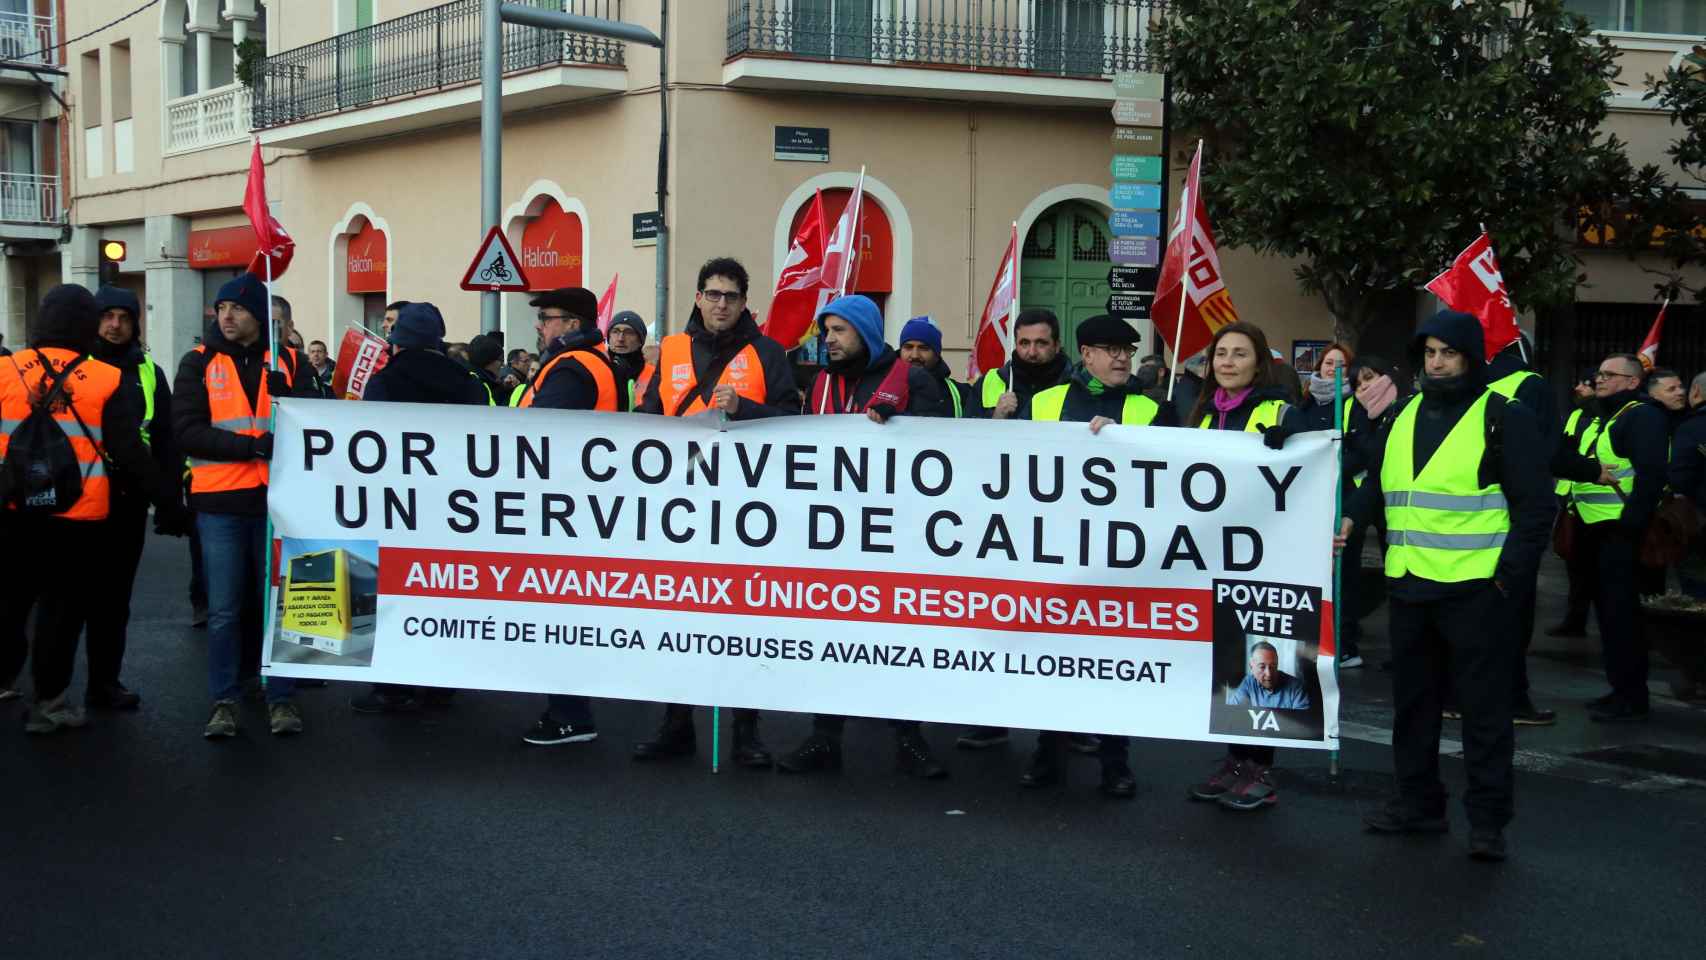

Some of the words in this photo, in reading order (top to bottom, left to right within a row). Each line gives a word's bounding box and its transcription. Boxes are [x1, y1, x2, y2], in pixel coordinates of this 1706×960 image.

[303, 428, 438, 476] POR
[467, 433, 550, 480] UN
[582, 438, 952, 497] CONVENIO
[983, 453, 1227, 513] JUSTO
[1257, 465, 1303, 512] Y
[335, 484, 418, 531] UN
[446, 488, 777, 548] SERVICIO
[808, 505, 894, 554] DE
[926, 511, 1264, 572] CALIDAD
[404, 561, 480, 591] AMB
[489, 566, 512, 592] Y
[517, 567, 734, 606] AVANZABAIX
[745, 572, 881, 614] ÚNICOS
[894, 586, 1199, 632] RESPONSABLES
[1217, 583, 1315, 613] POVEDA
[1235, 609, 1293, 635] VETE
[403, 616, 497, 641] COMITÉ
[505, 622, 537, 643] DE
[545, 625, 646, 650] HUELGA
[657, 631, 814, 661] AUTOBUSES
[820, 641, 925, 668] AVANZA
[934, 648, 996, 673] BAIX
[1005, 652, 1172, 684] LLOBREGAT
[1248, 709, 1280, 731] YA
